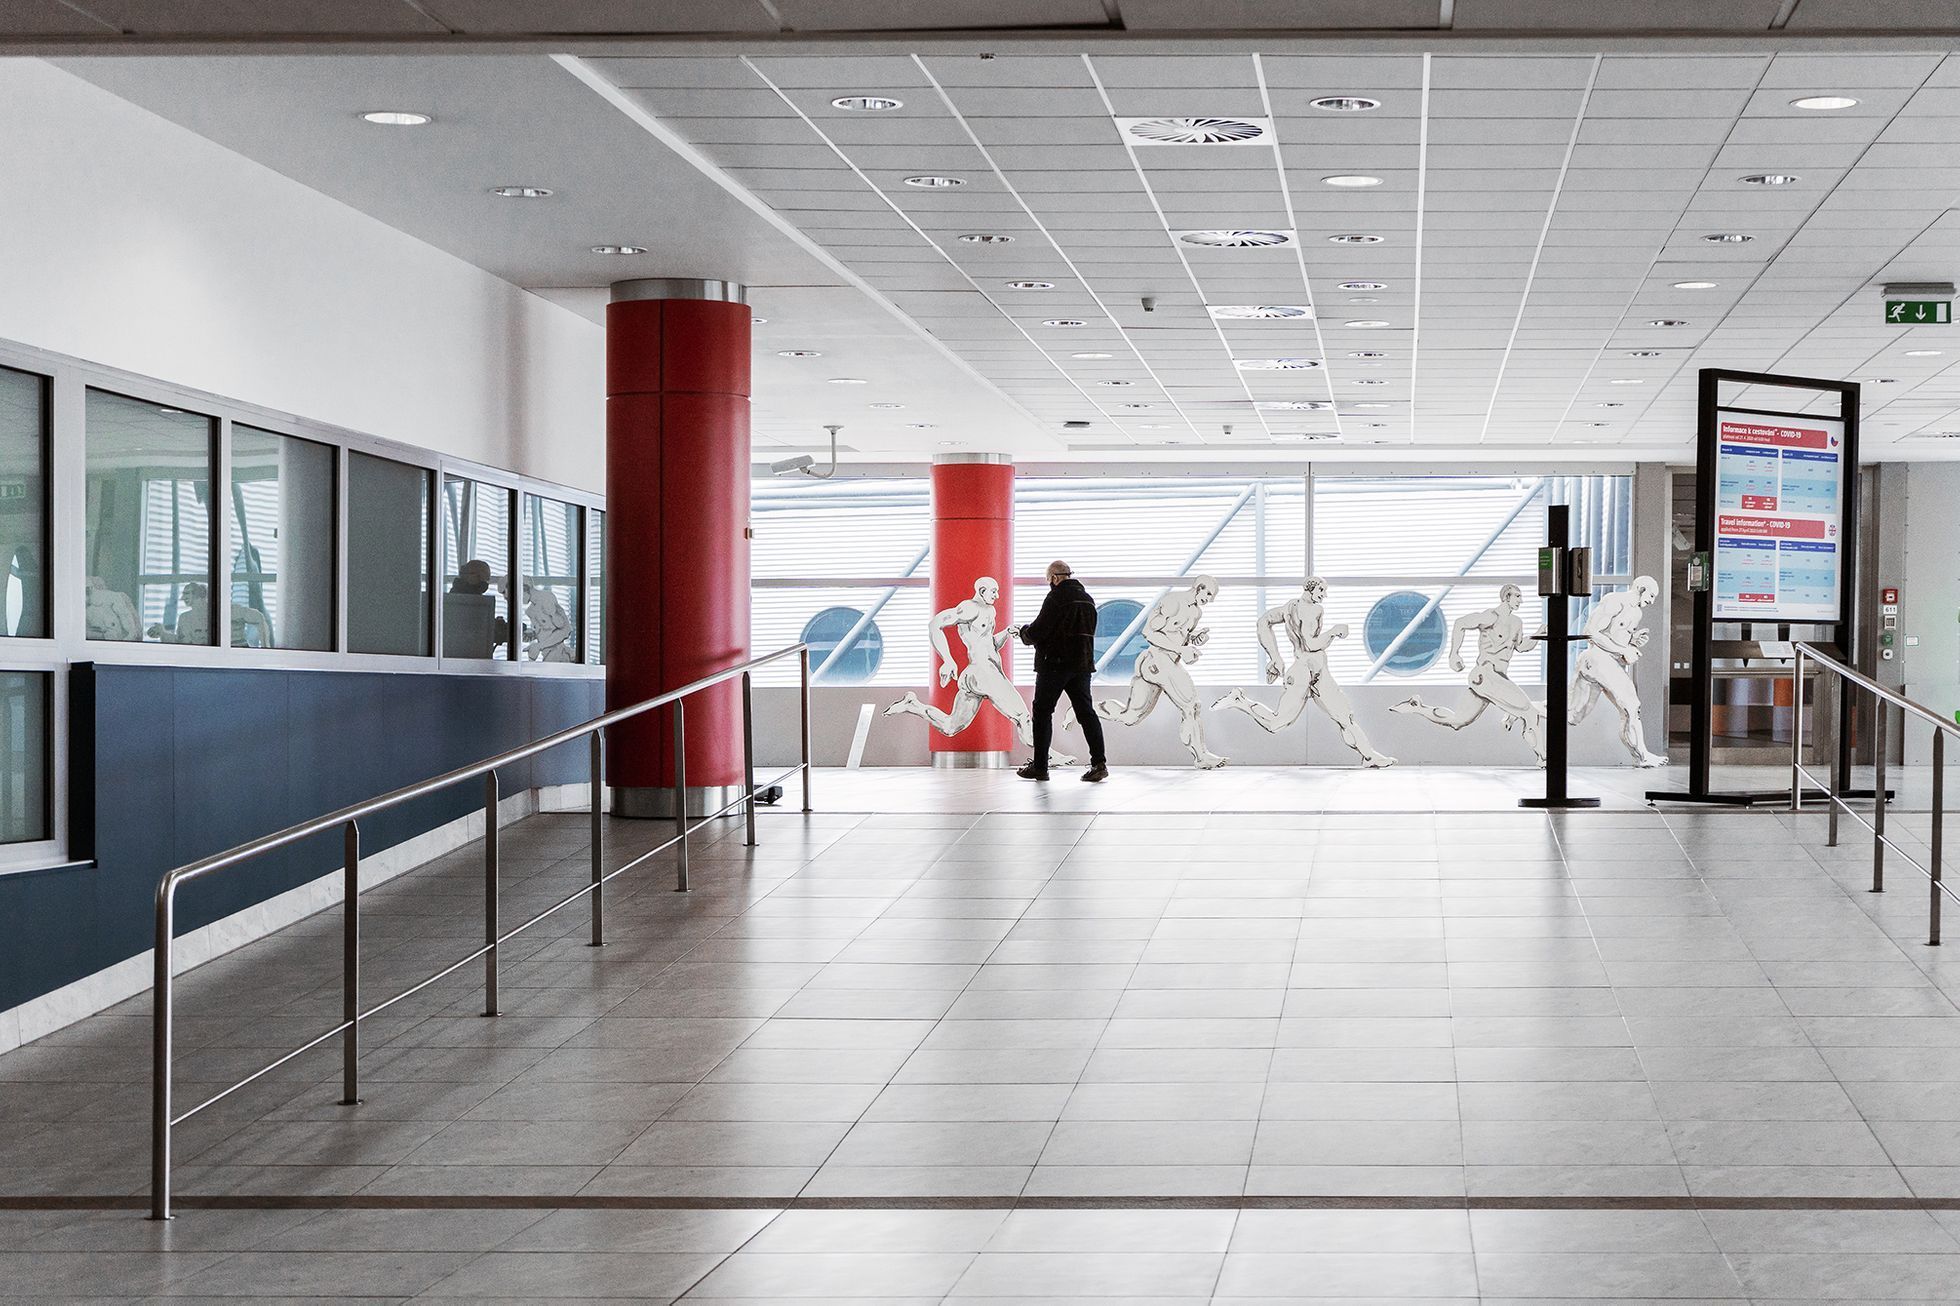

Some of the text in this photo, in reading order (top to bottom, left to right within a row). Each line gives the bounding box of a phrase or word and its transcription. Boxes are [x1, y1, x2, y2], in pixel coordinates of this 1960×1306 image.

[1723, 425, 1747, 434] Informace
[1781, 431, 1802, 439] COVID-19
[1721, 518, 1736, 526] Travel
[1770, 521, 1791, 529] COVID-19
